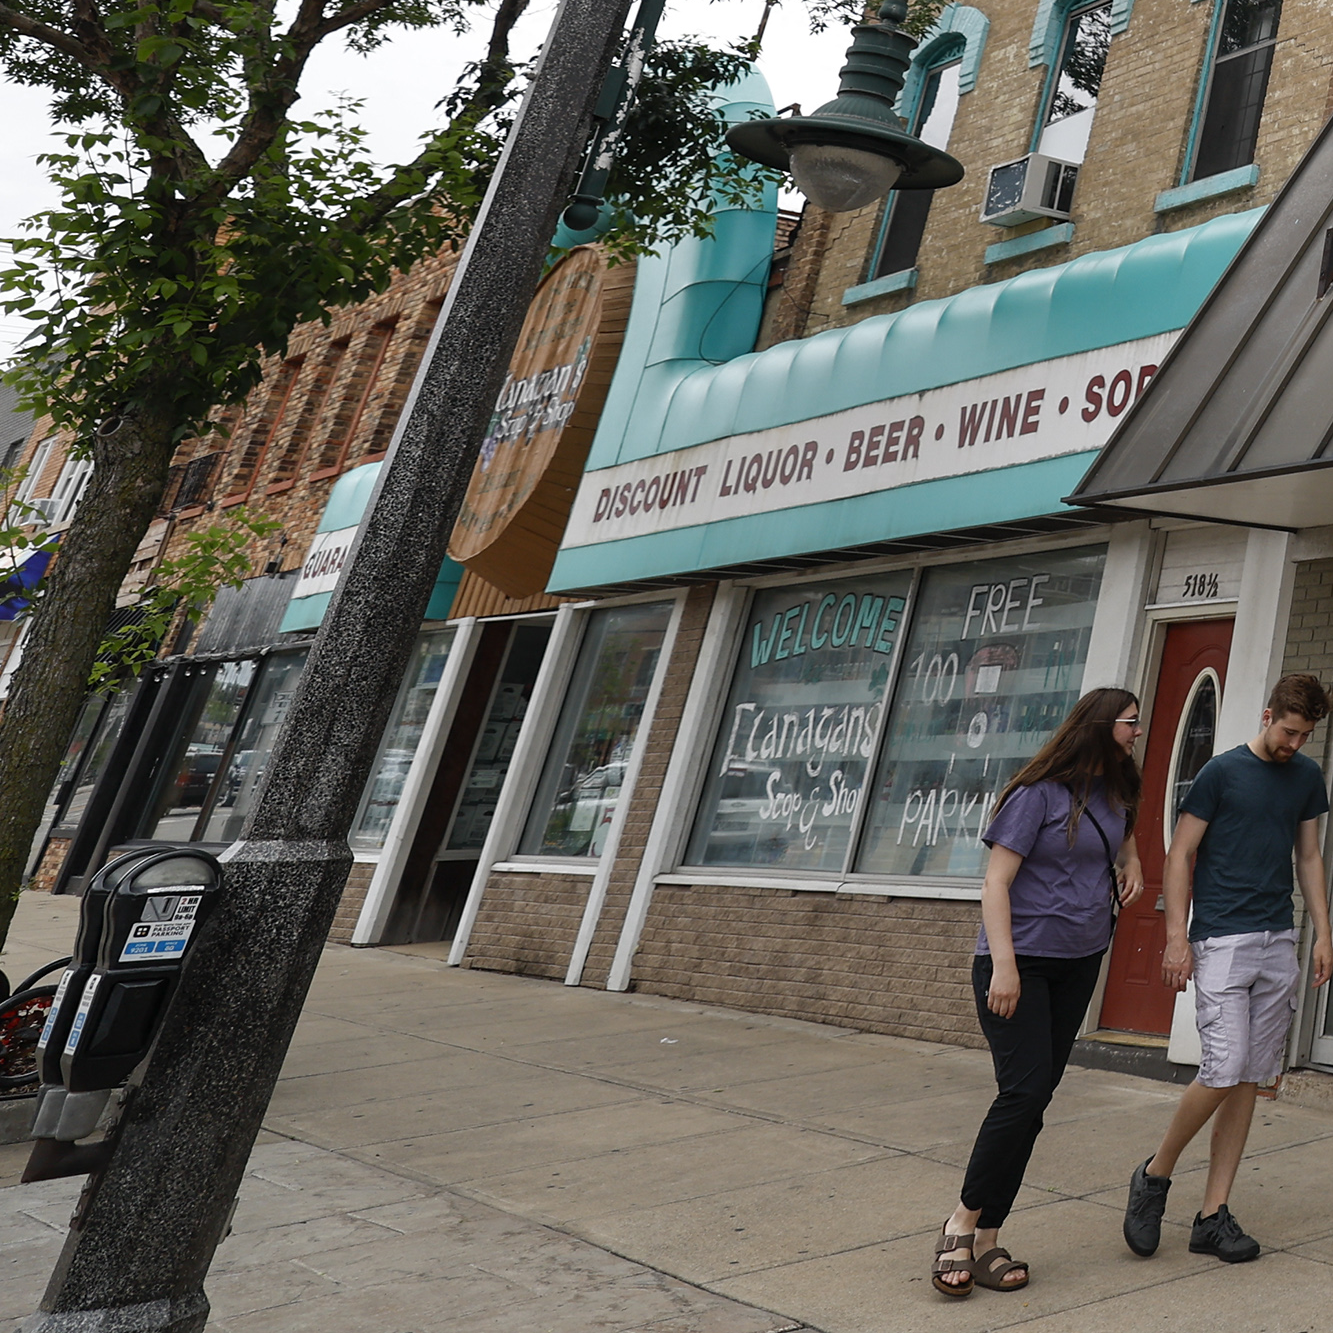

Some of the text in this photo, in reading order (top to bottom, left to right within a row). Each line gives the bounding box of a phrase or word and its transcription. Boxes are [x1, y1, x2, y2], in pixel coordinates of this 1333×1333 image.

[593, 465, 708, 523] DISCOUNT
[719, 441, 818, 498] LIQUOR
[843, 415, 925, 472] BEER
[958, 388, 1046, 449] WINE
[751, 593, 906, 668] WELCOME
[961, 573, 1050, 641] FREE
[911, 652, 959, 707] 100
[760, 770, 802, 831] Stop
[177, 906, 197, 914] LIMIT
[181, 897, 200, 905] 2 HR
